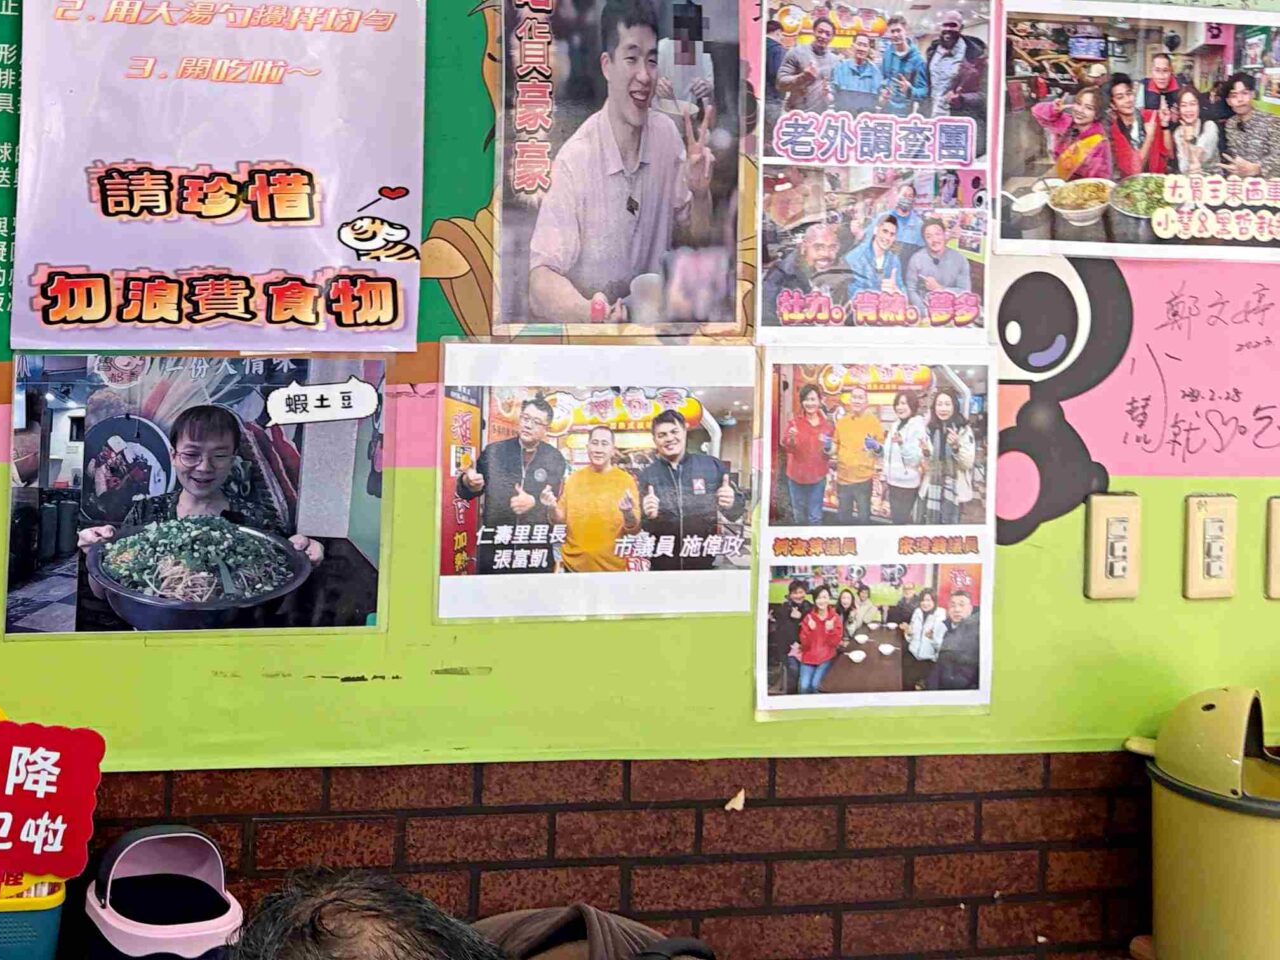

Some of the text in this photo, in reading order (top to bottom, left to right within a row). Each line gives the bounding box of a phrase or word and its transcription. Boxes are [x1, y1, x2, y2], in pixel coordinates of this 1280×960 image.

[778, 115, 975, 164] 老外調查團
[98, 167, 317, 223] 請珍惜
[40, 273, 404, 330] 勿浪費食物
[285, 391, 354, 415] 蝦土豆
[476, 524, 567, 546] 仁壽里里長
[614, 534, 745, 559] 市議員 施偉政
[492, 548, 549, 570] 張富凱
